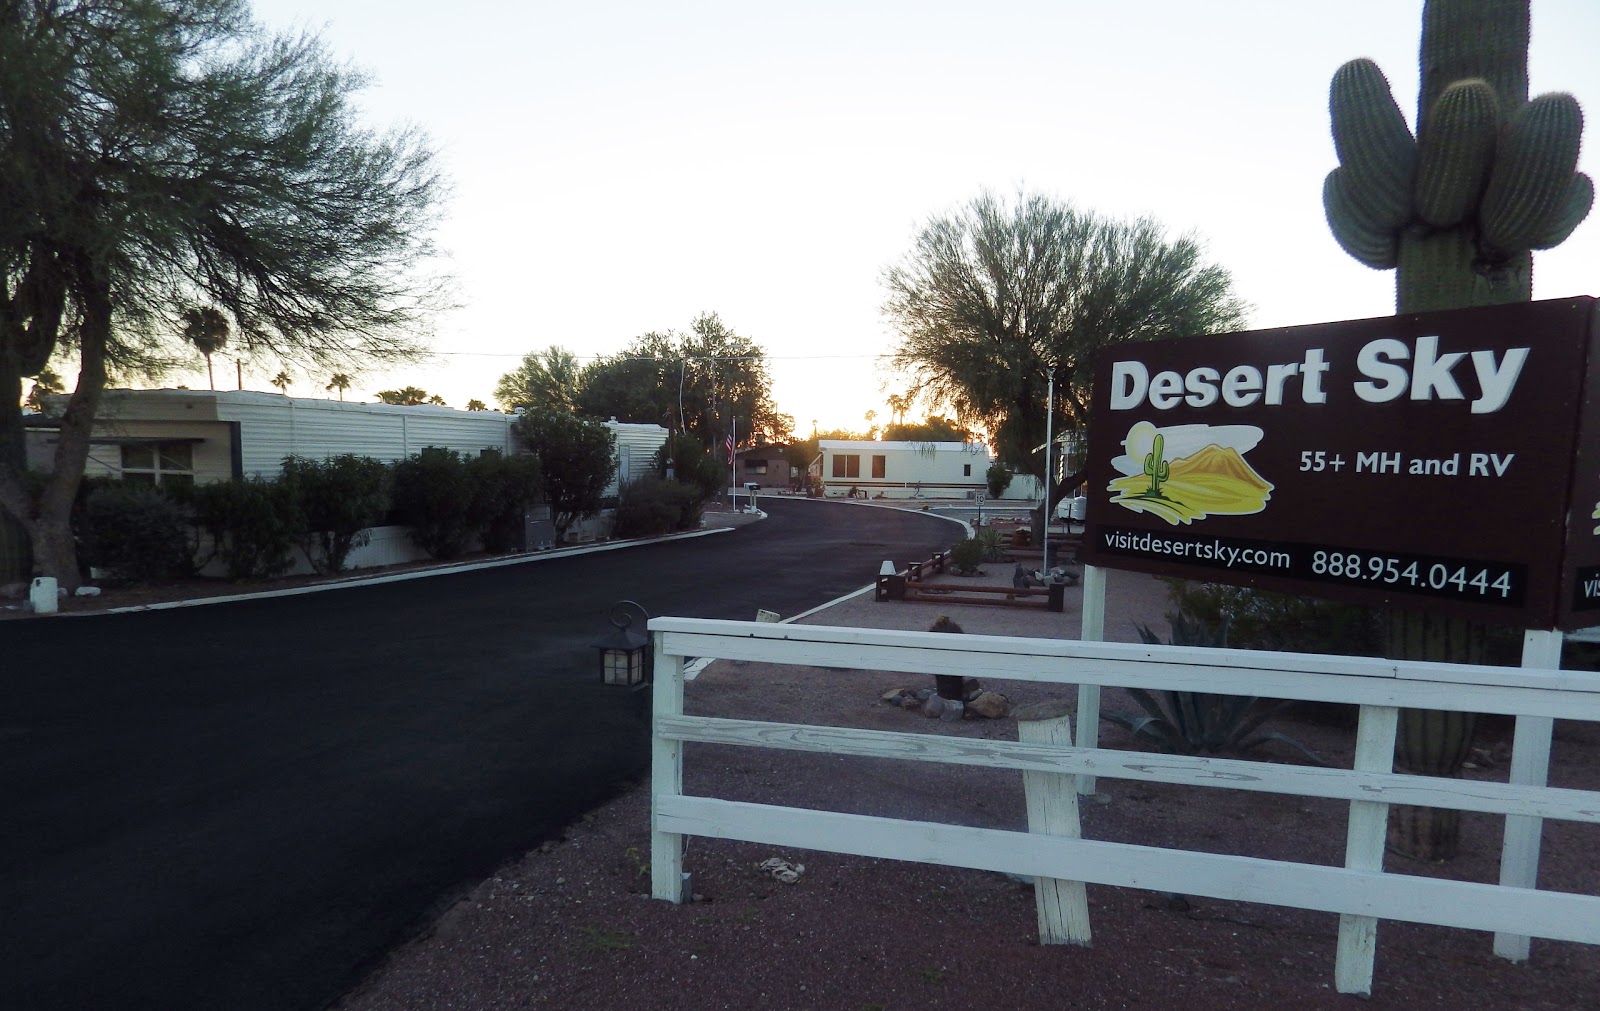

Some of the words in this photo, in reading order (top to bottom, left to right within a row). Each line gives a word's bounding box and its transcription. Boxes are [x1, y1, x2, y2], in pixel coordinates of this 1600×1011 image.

[1110, 348, 1331, 410] Desert
[1353, 336, 1531, 414] Sky
[1300, 451, 1346, 472] 55+
[1355, 452, 1400, 474] MH
[1409, 453, 1458, 476] and
[1469, 453, 1515, 477] RV
[1105, 530, 1290, 569] visitdesertsky.com
[1311, 550, 1511, 598] 888.954.0444
